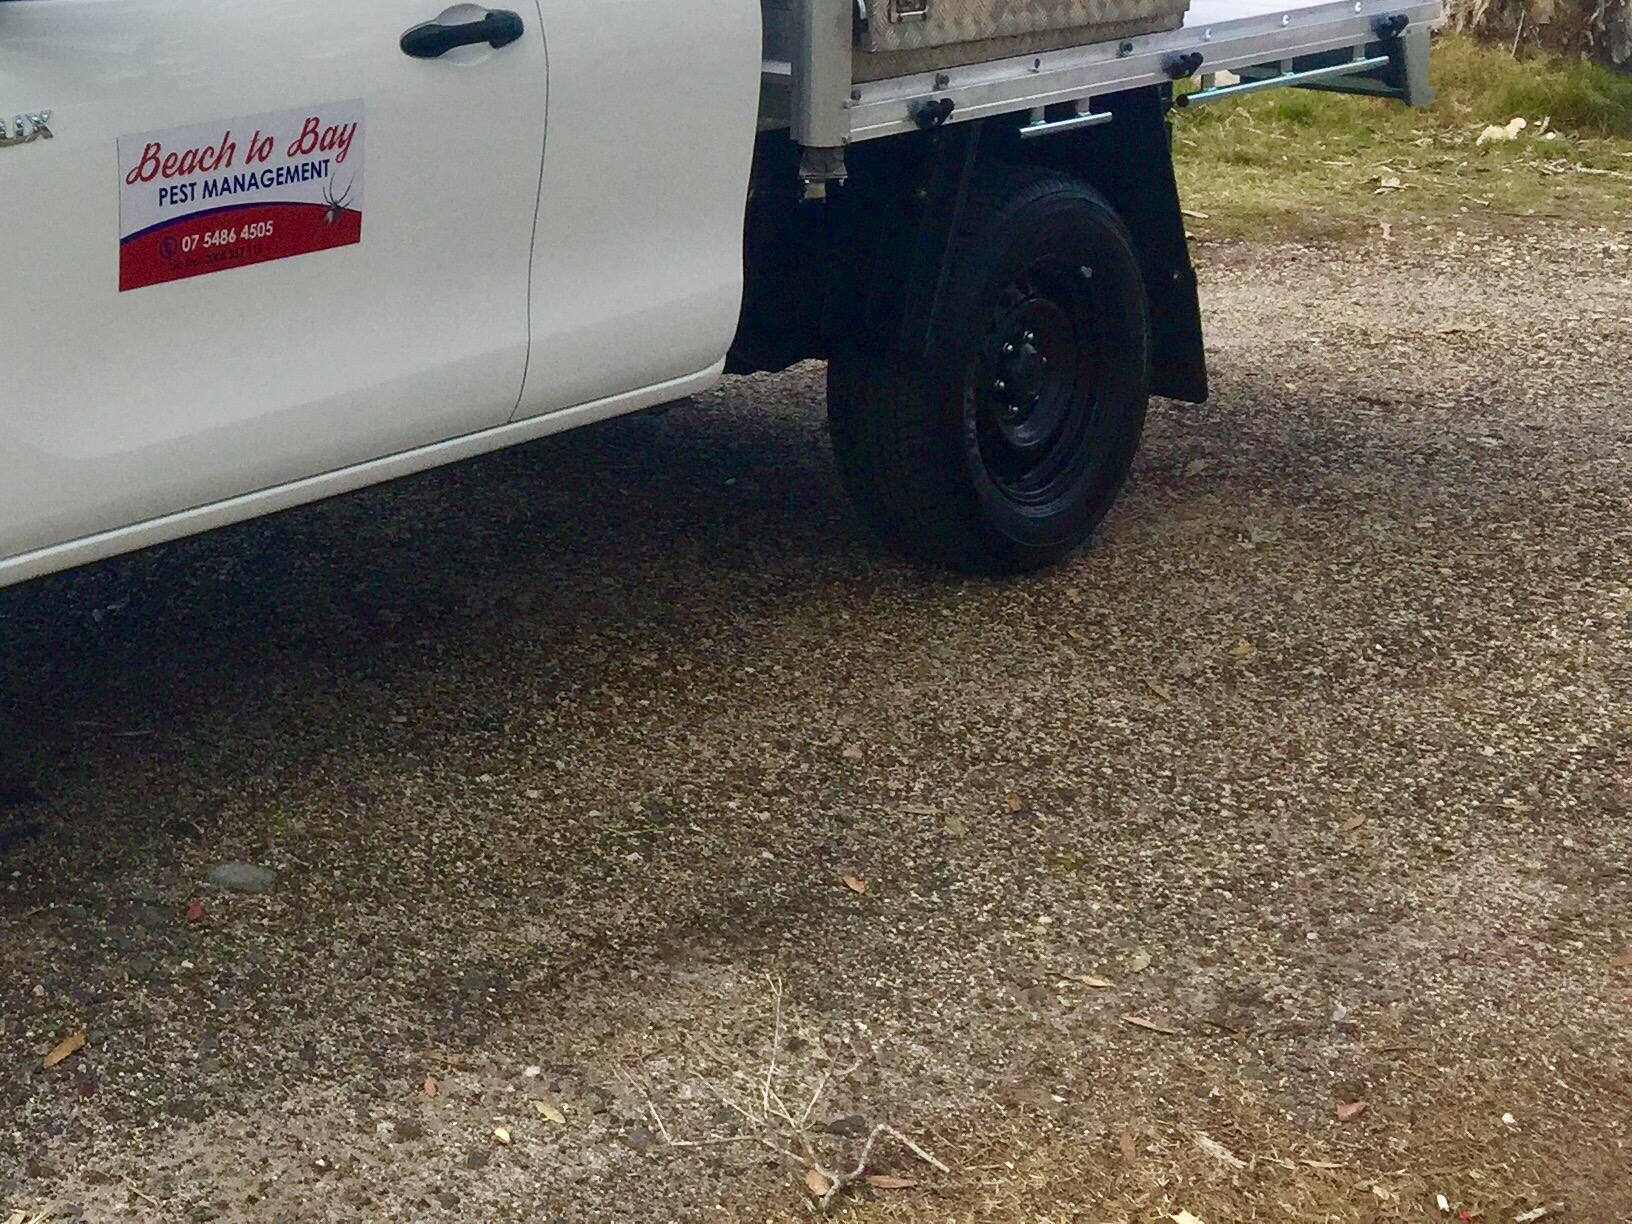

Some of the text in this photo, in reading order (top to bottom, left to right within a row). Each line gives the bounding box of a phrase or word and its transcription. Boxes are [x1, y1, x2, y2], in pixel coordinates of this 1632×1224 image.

[126, 116, 358, 185] Beach to Bay
[159, 159, 330, 207] PEST MANAGEMENT
[181, 220, 273, 252] 07 5486 4505
